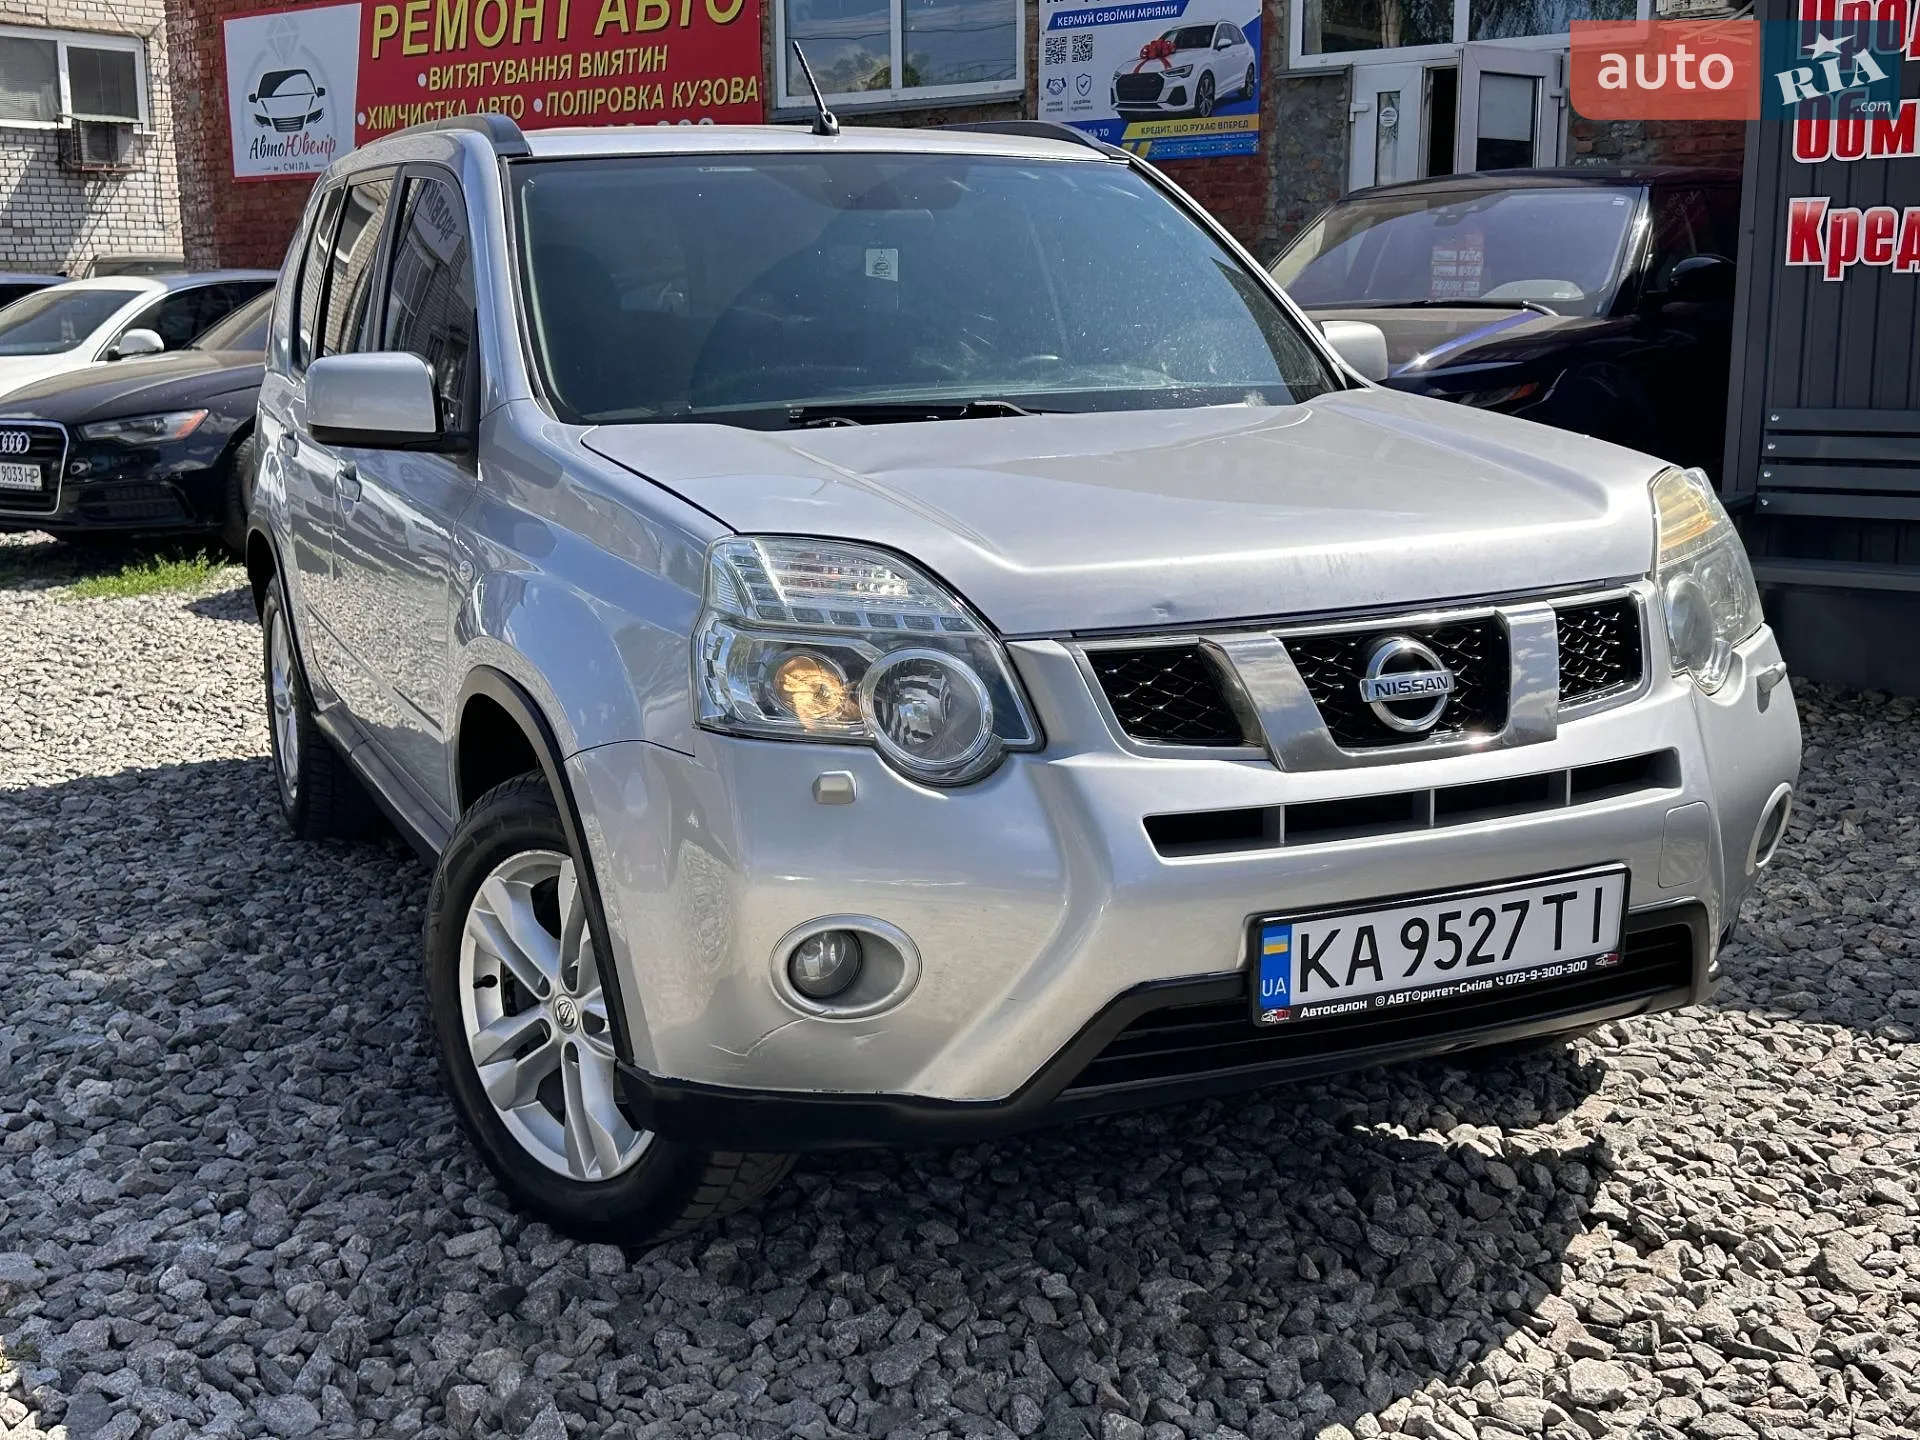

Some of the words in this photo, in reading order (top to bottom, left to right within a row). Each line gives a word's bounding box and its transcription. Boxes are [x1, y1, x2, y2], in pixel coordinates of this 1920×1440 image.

[1057, 15, 1095, 27] КЕРМУЙ
[1096, 8, 1135, 23] СВОЇМИ
[1137, 5, 1178, 19] МРІЯМИ
[1797, 0, 1920, 75] Про
[429, 54, 573, 91] ВИТЯГУВАННЯ
[579, 45, 668, 78] ВМЯТИН
[367, 100, 467, 130] ХІМЧИСТКА
[477, 95, 525, 120] АВТО
[546, 83, 665, 117] ПОЛІРОВКА
[672, 75, 759, 108] КУЗОВА
[249, 131, 336, 162] АвтоЮвелір
[2, 465, 24, 482] 9033
[1375, 676, 1448, 696] NISSAN
[1300, 925, 1384, 993] KA
[1400, 904, 1529, 978] 9527
[1542, 887, 1604, 951] TI
[1261, 977, 1287, 998] UA
[1300, 999, 1368, 1018] Автосалон
[1505, 960, 1588, 985] 073-9-300-300
